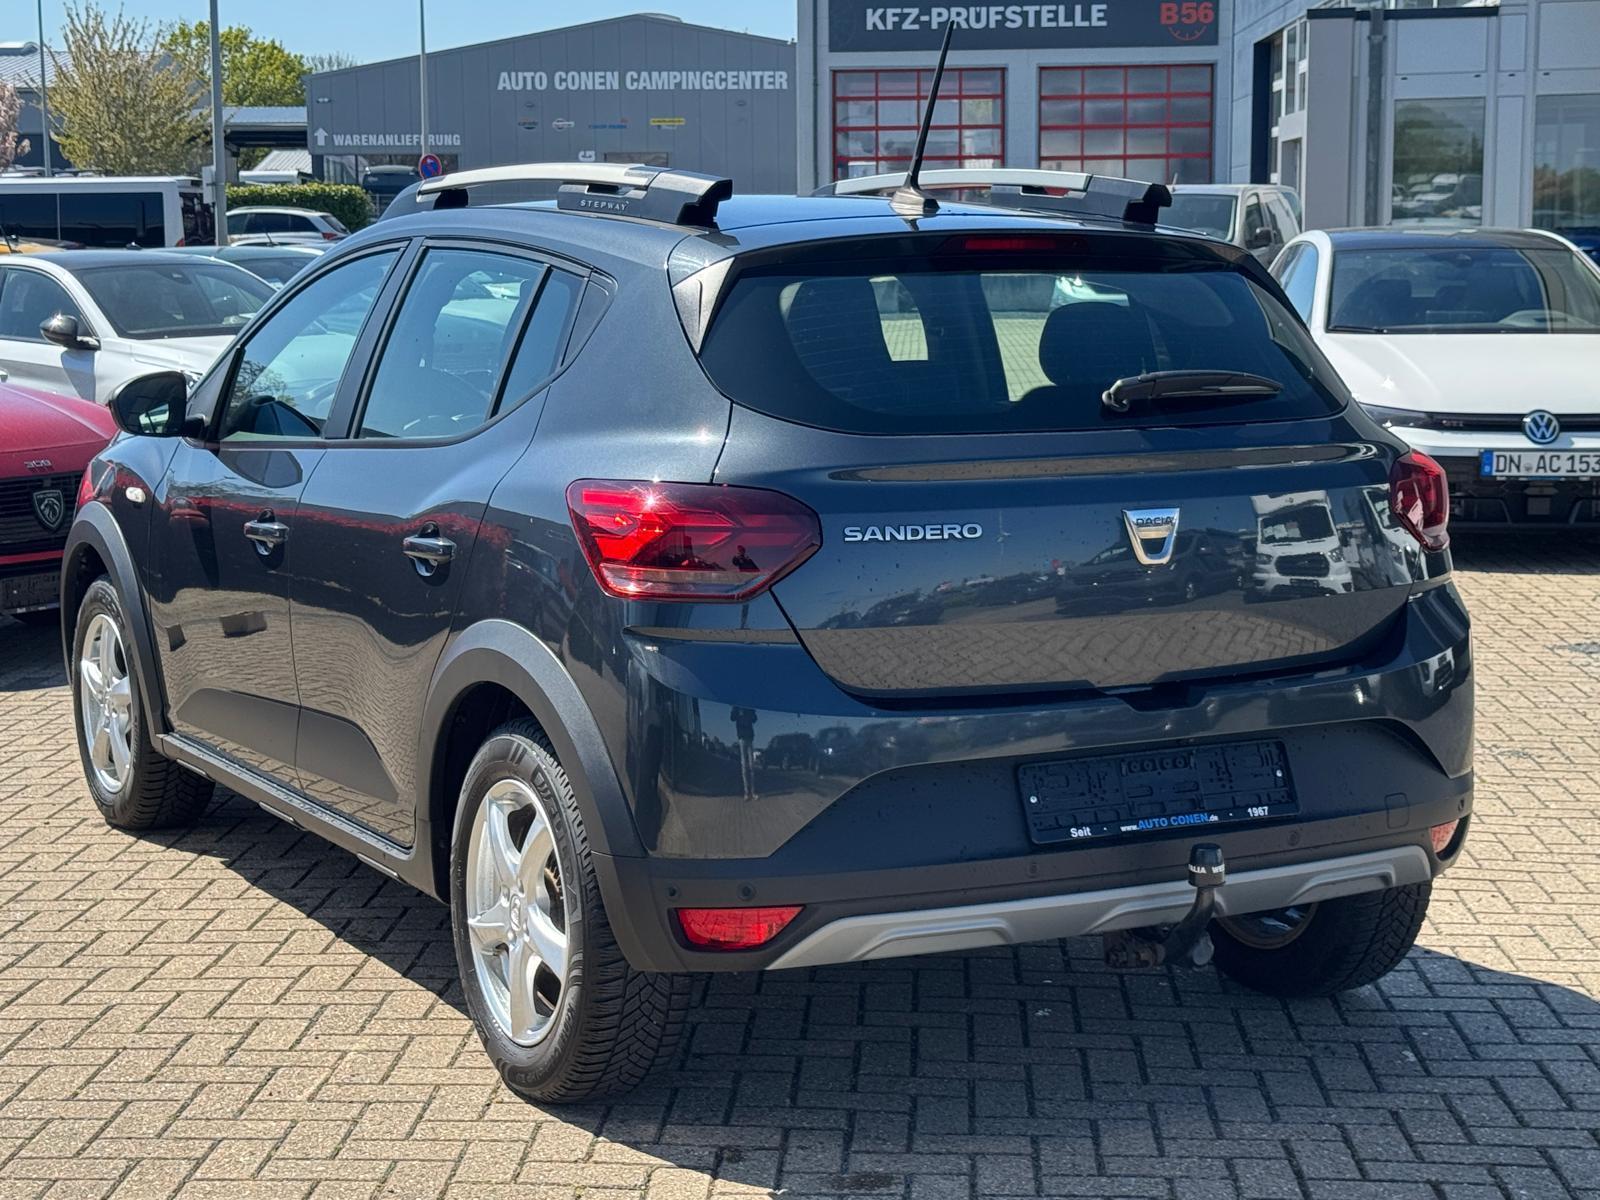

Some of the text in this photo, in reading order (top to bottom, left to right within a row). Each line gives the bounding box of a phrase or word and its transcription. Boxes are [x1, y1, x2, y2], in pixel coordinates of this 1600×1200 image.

[865, 4, 1108, 31] KFZ-PRÜFSTELLE
[1159, 2, 1215, 25] B56
[497, 71, 788, 91] AUTO CONEN CAMPINGCENTER
[580, 199, 627, 211] STEPWAY
[1495, 454, 1600, 473] DN AC 153
[1135, 516, 1173, 527] DACIA
[844, 523, 983, 542] SANDERO
[1070, 826, 1092, 838] Seit
[1247, 806, 1269, 818] 1967
